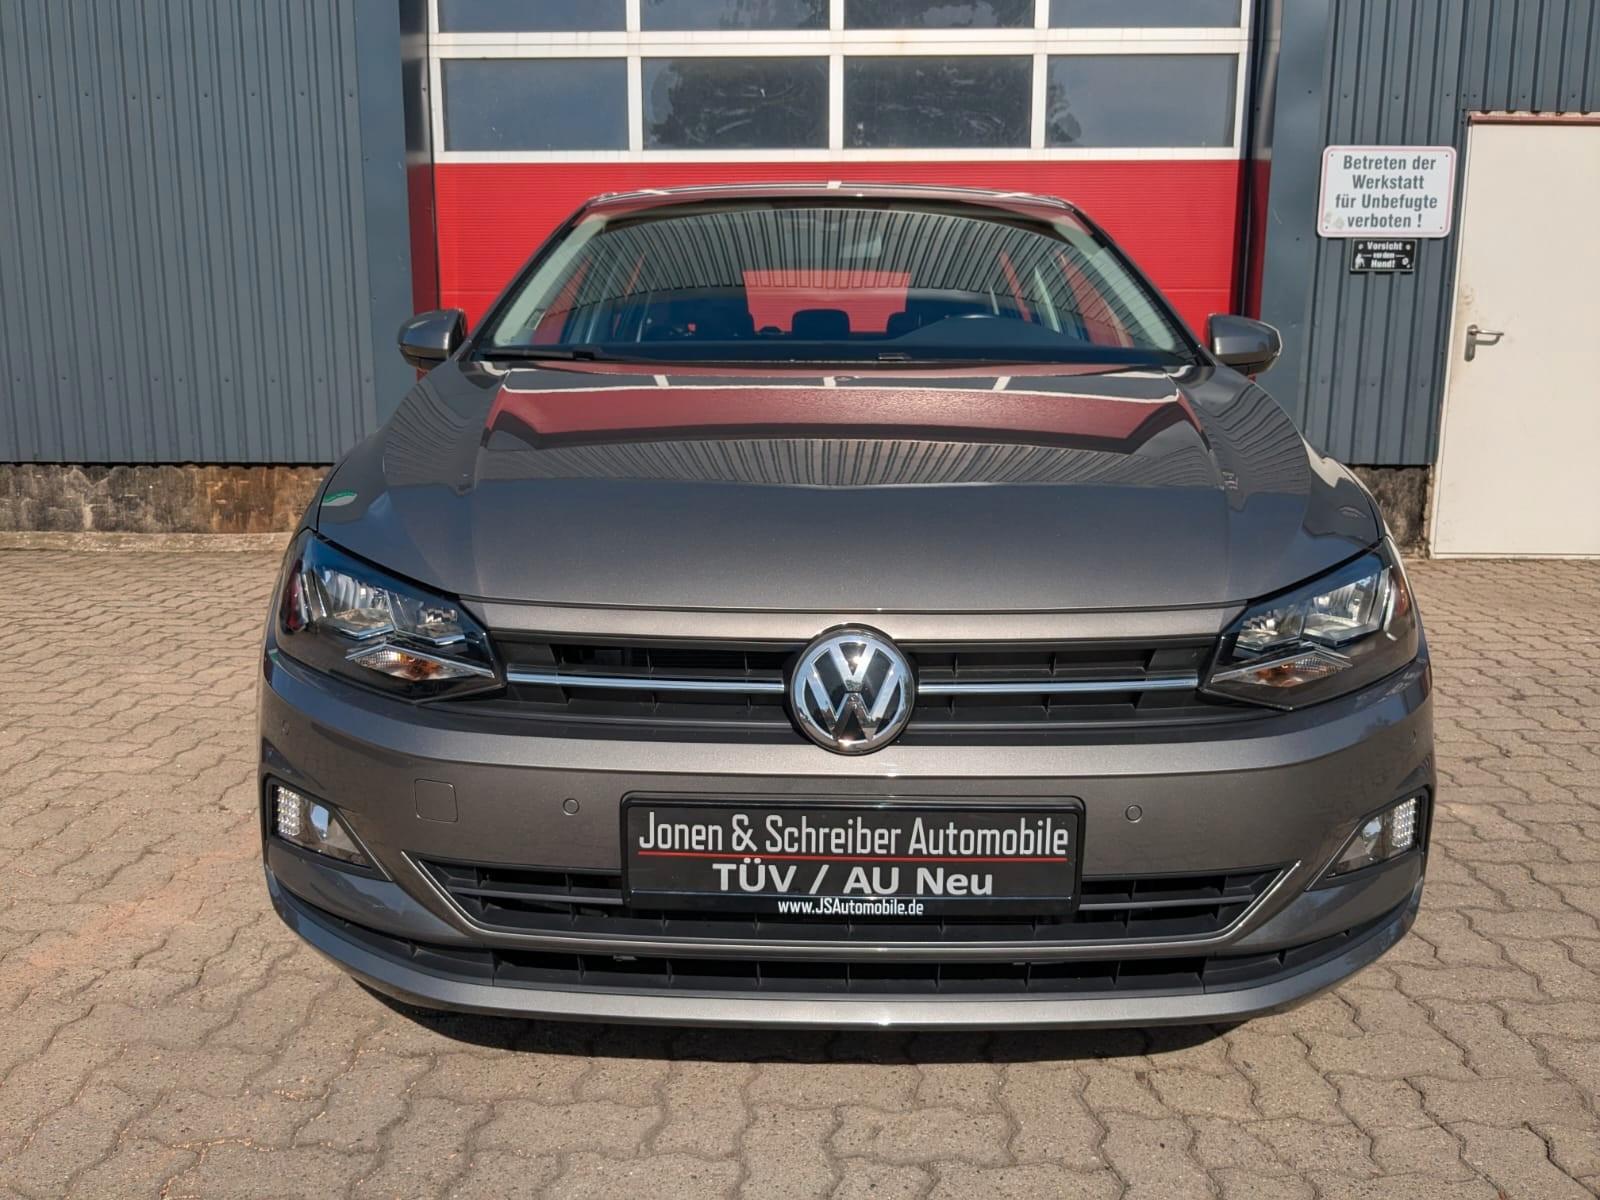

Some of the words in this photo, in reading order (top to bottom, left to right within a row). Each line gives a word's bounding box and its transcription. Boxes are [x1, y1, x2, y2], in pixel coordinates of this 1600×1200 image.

[1343, 155, 1407, 170] Betreten
[1412, 155, 1437, 170] der
[1352, 174, 1425, 190] Werkstatt
[1335, 194, 1357, 209] für
[1362, 194, 1438, 212] Unbefugte
[1347, 213, 1412, 228] verboten
[1367, 241, 1403, 251] Vorsicht
[639, 811, 723, 851] Jonen
[731, 814, 758, 852] &
[765, 814, 902, 854] Schreiber
[908, 817, 1069, 856] Automobile
[712, 857, 797, 892] TÜV
[808, 864, 830, 895] /
[842, 866, 900, 895] AU
[916, 867, 993, 896] Neu
[777, 897, 924, 916] www.JSAutomobile.de
